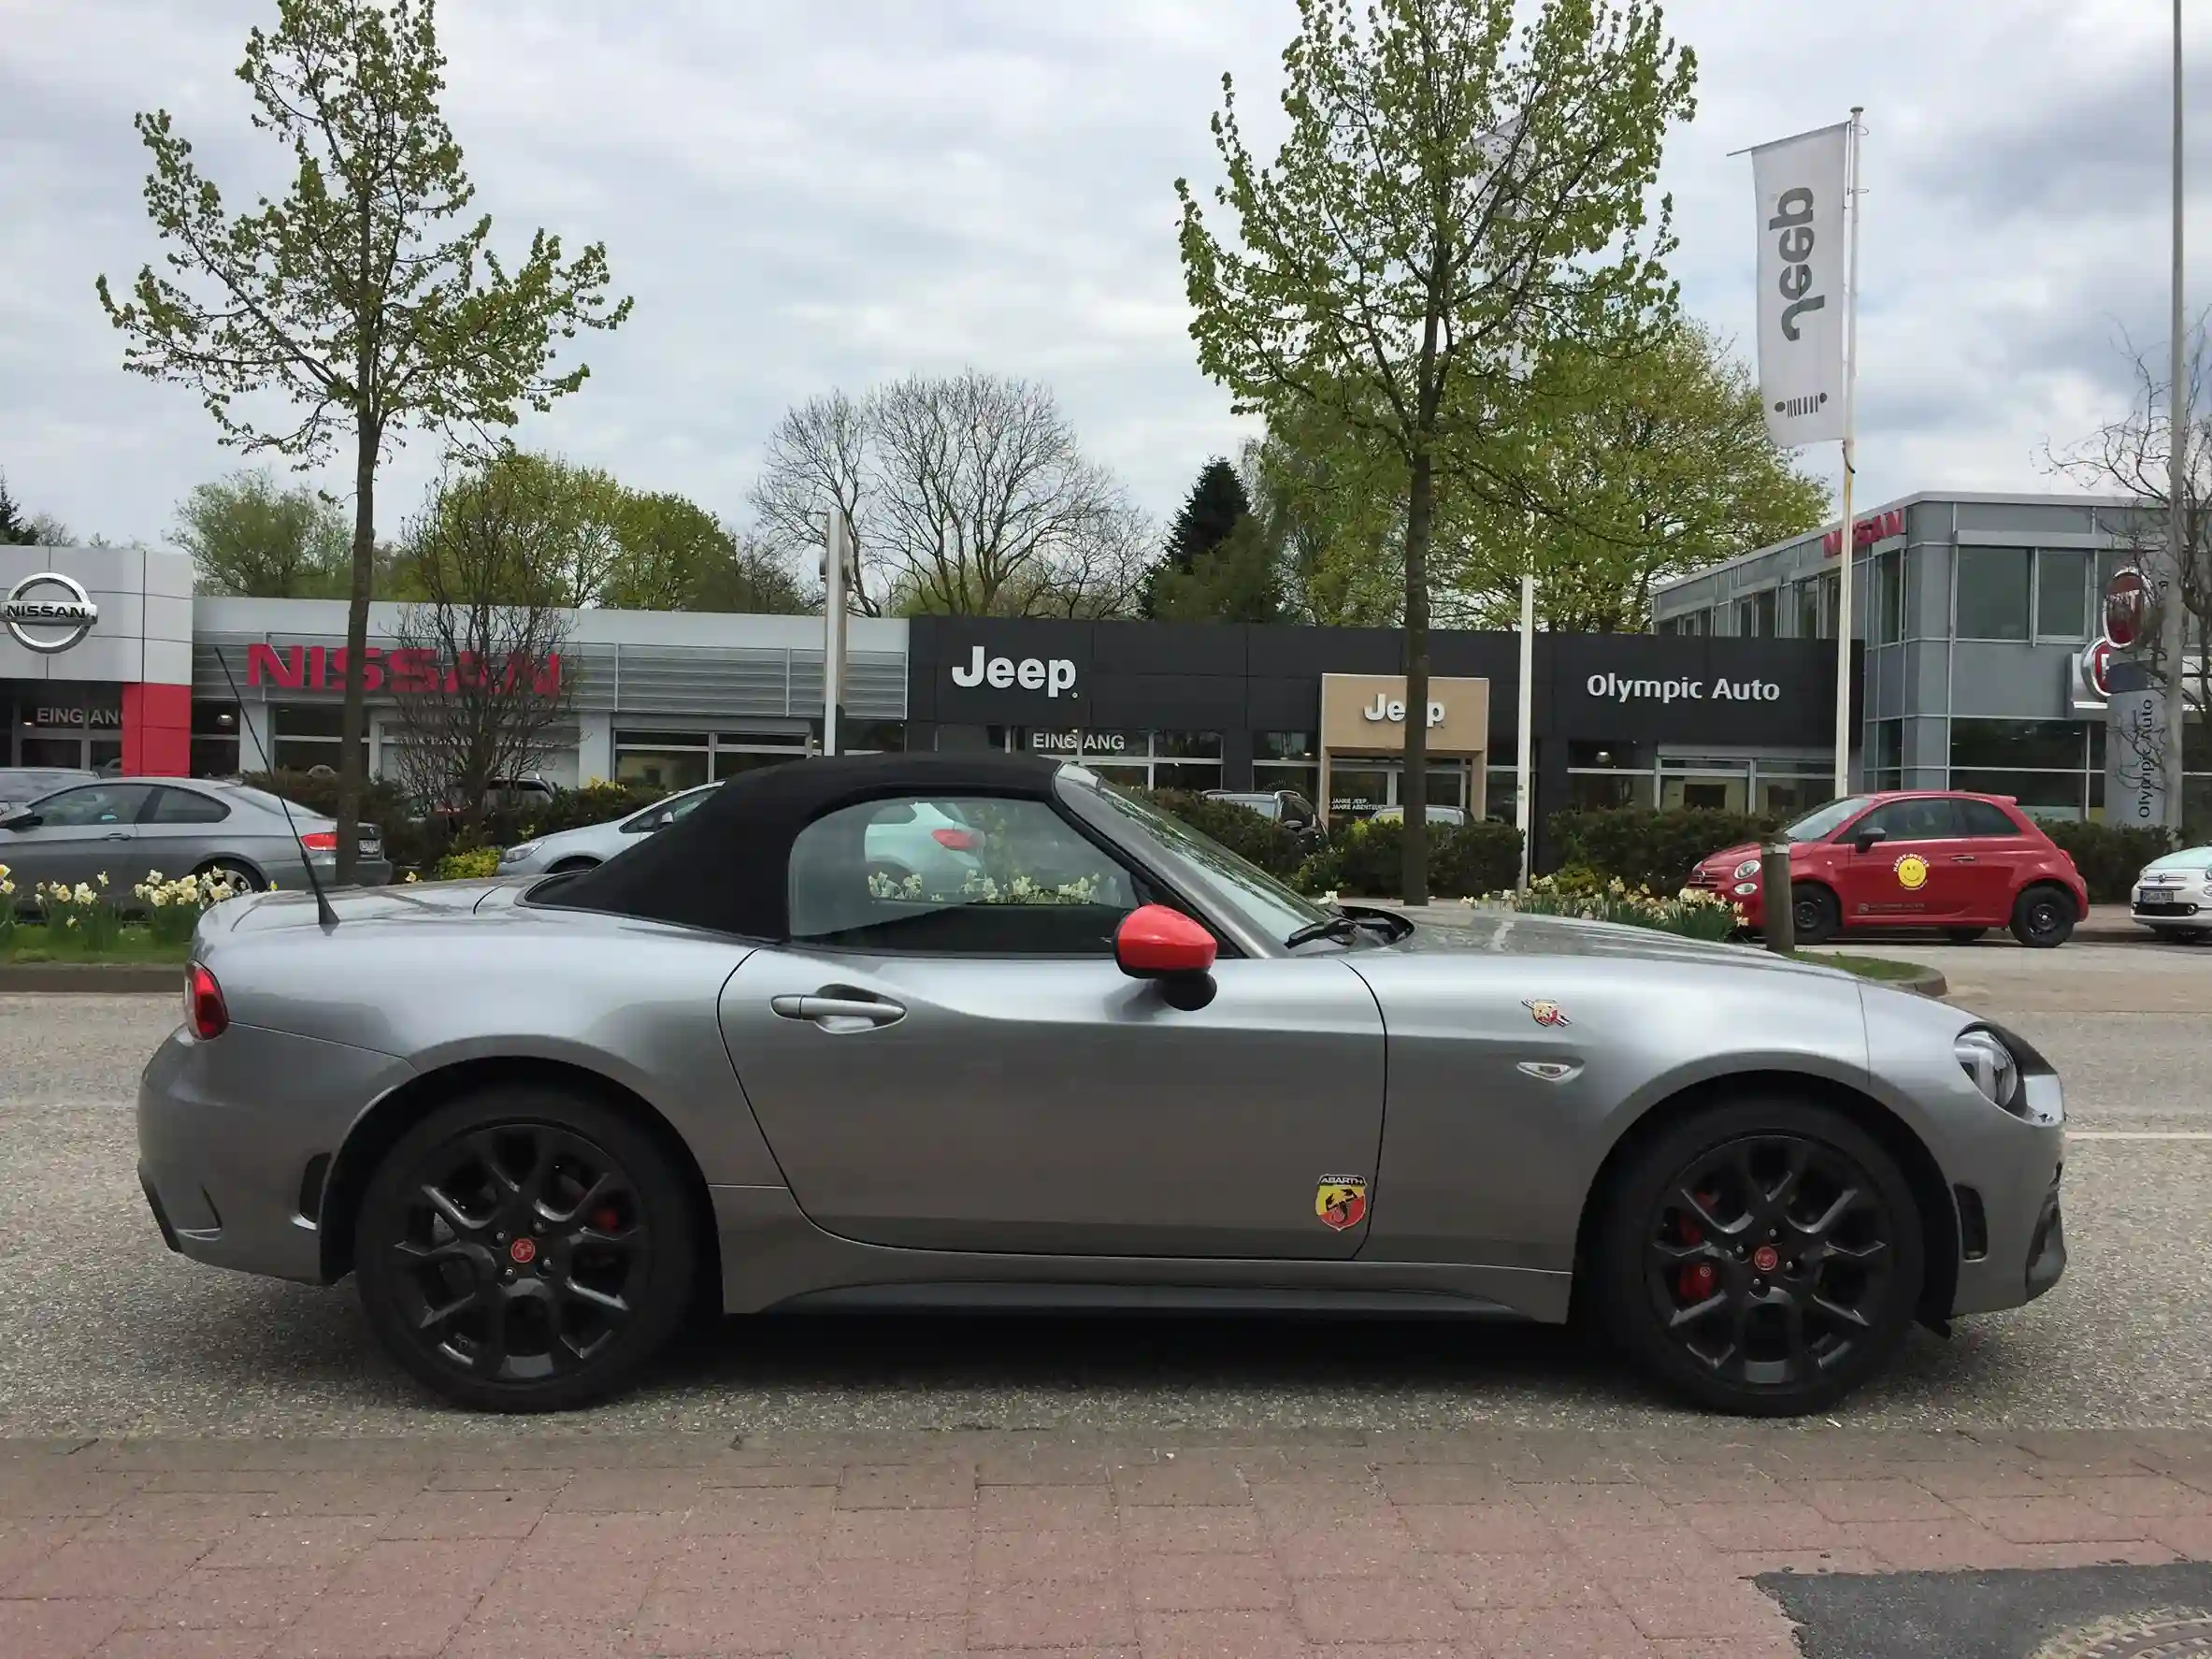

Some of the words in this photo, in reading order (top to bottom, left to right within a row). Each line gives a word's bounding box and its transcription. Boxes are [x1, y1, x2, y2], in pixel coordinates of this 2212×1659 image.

[7, 605, 86, 619] NISSAN
[952, 646, 1077, 698] Jeep
[1587, 672, 1703, 704] Olympic
[1711, 678, 1780, 700] Auto
[36, 708, 123, 725] EINGAN
[1364, 693, 1445, 728] Jep
[1032, 732, 1125, 750] EINGANG
